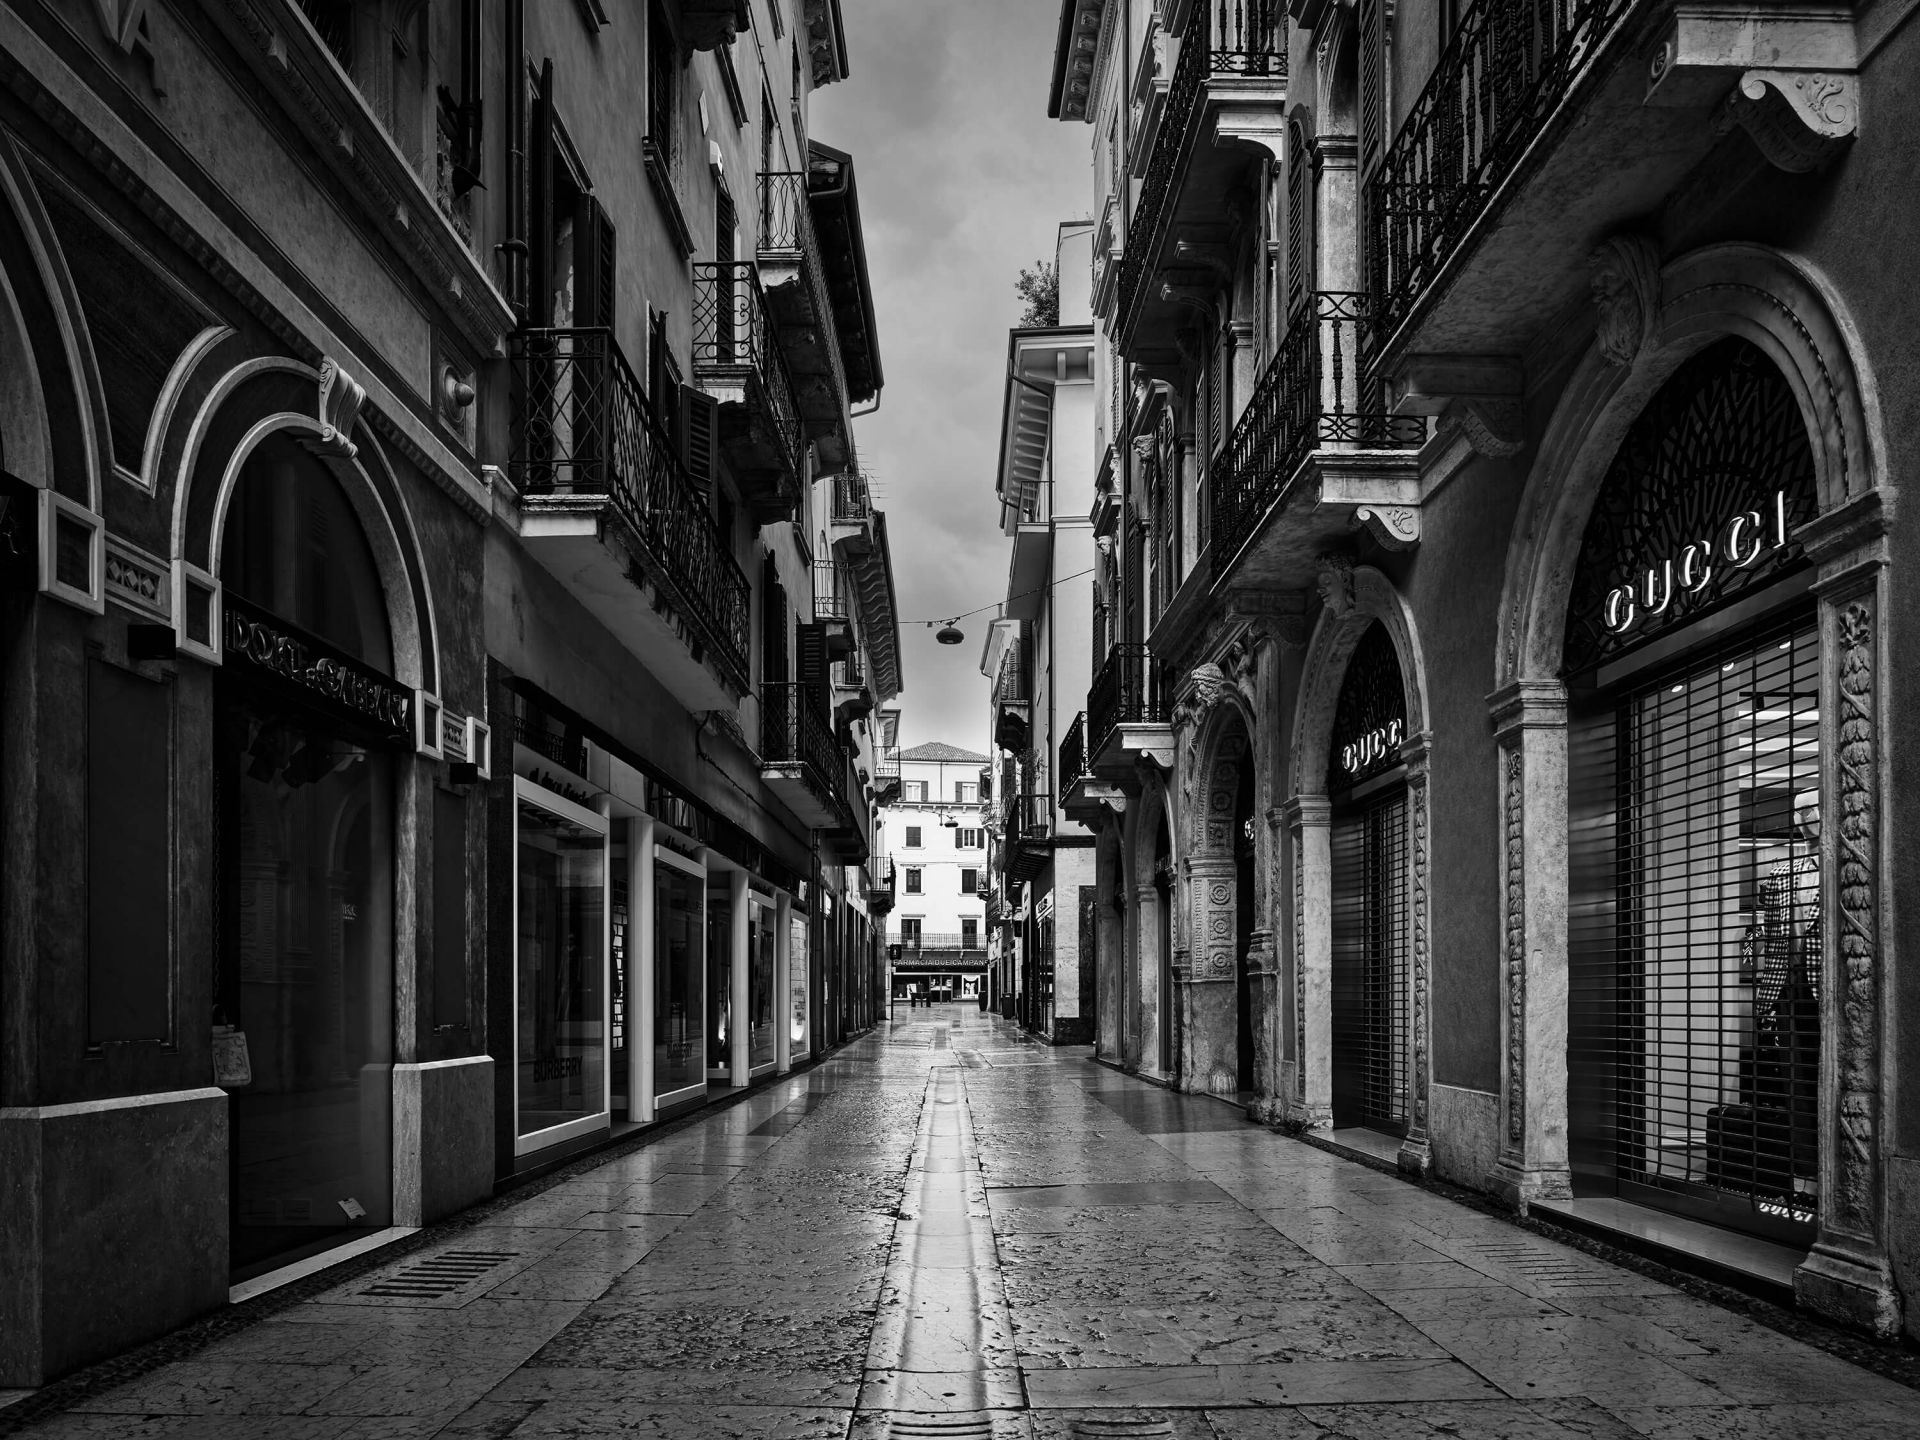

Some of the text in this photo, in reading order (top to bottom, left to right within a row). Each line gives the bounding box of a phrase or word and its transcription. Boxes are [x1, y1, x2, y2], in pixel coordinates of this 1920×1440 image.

[1604, 490, 1787, 633] GUCCI
[1342, 718, 1403, 774] GUCC
[533, 1056, 583, 1083] BURBERRY
[1759, 1202, 1814, 1223] GUCCI
